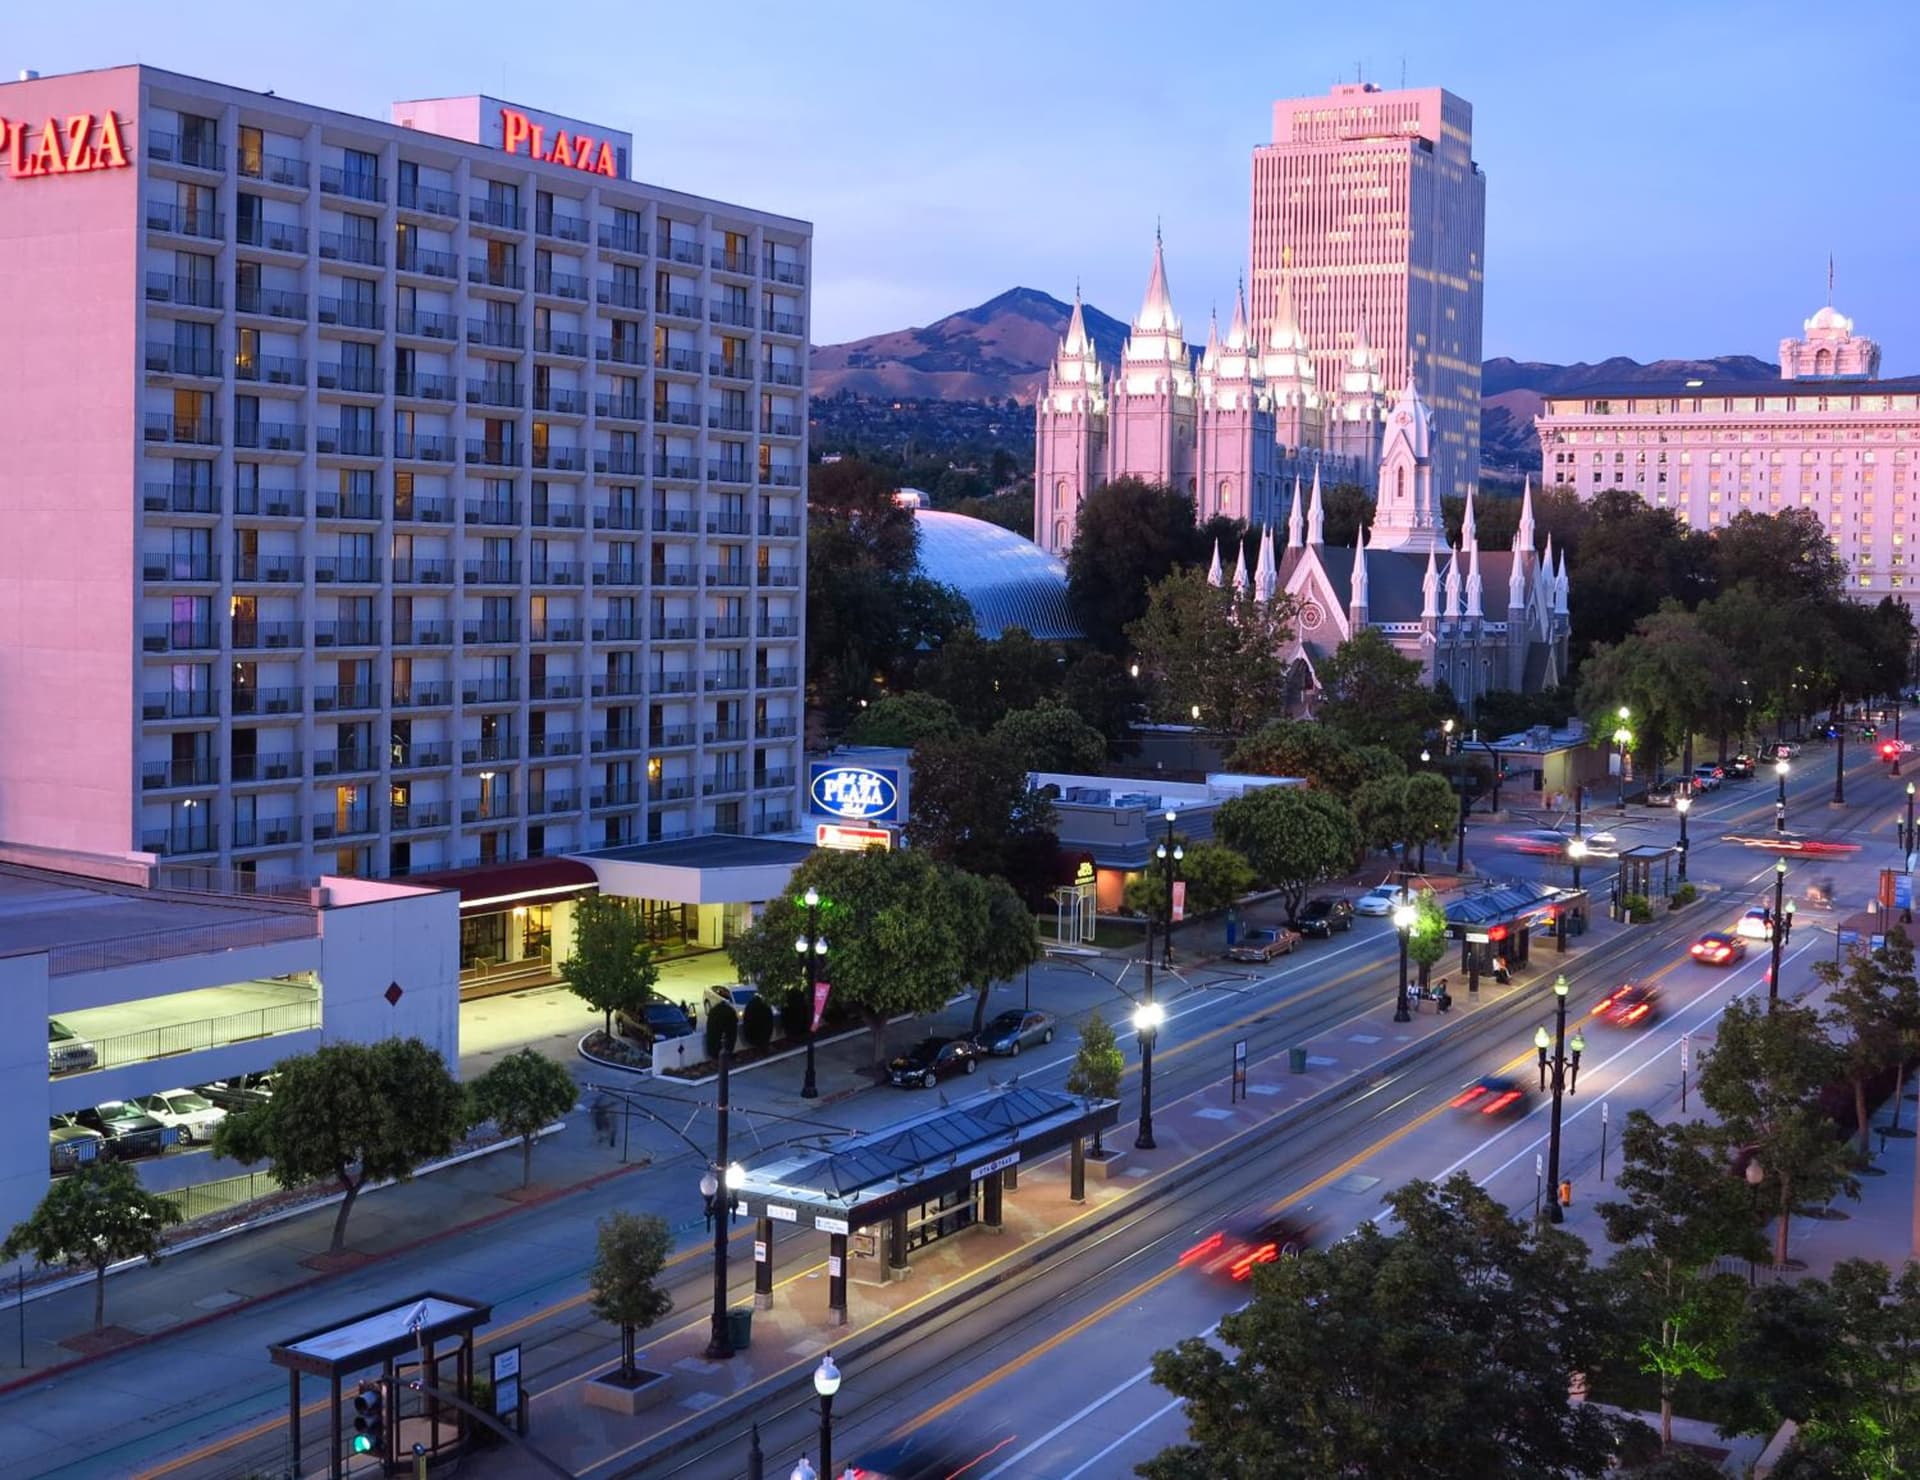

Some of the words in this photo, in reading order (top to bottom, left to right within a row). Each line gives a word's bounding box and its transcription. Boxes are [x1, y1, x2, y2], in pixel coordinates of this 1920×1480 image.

[0, 110, 129, 178] LAZA
[500, 108, 617, 178] PLAZA
[823, 779, 884, 805] PLAZA
